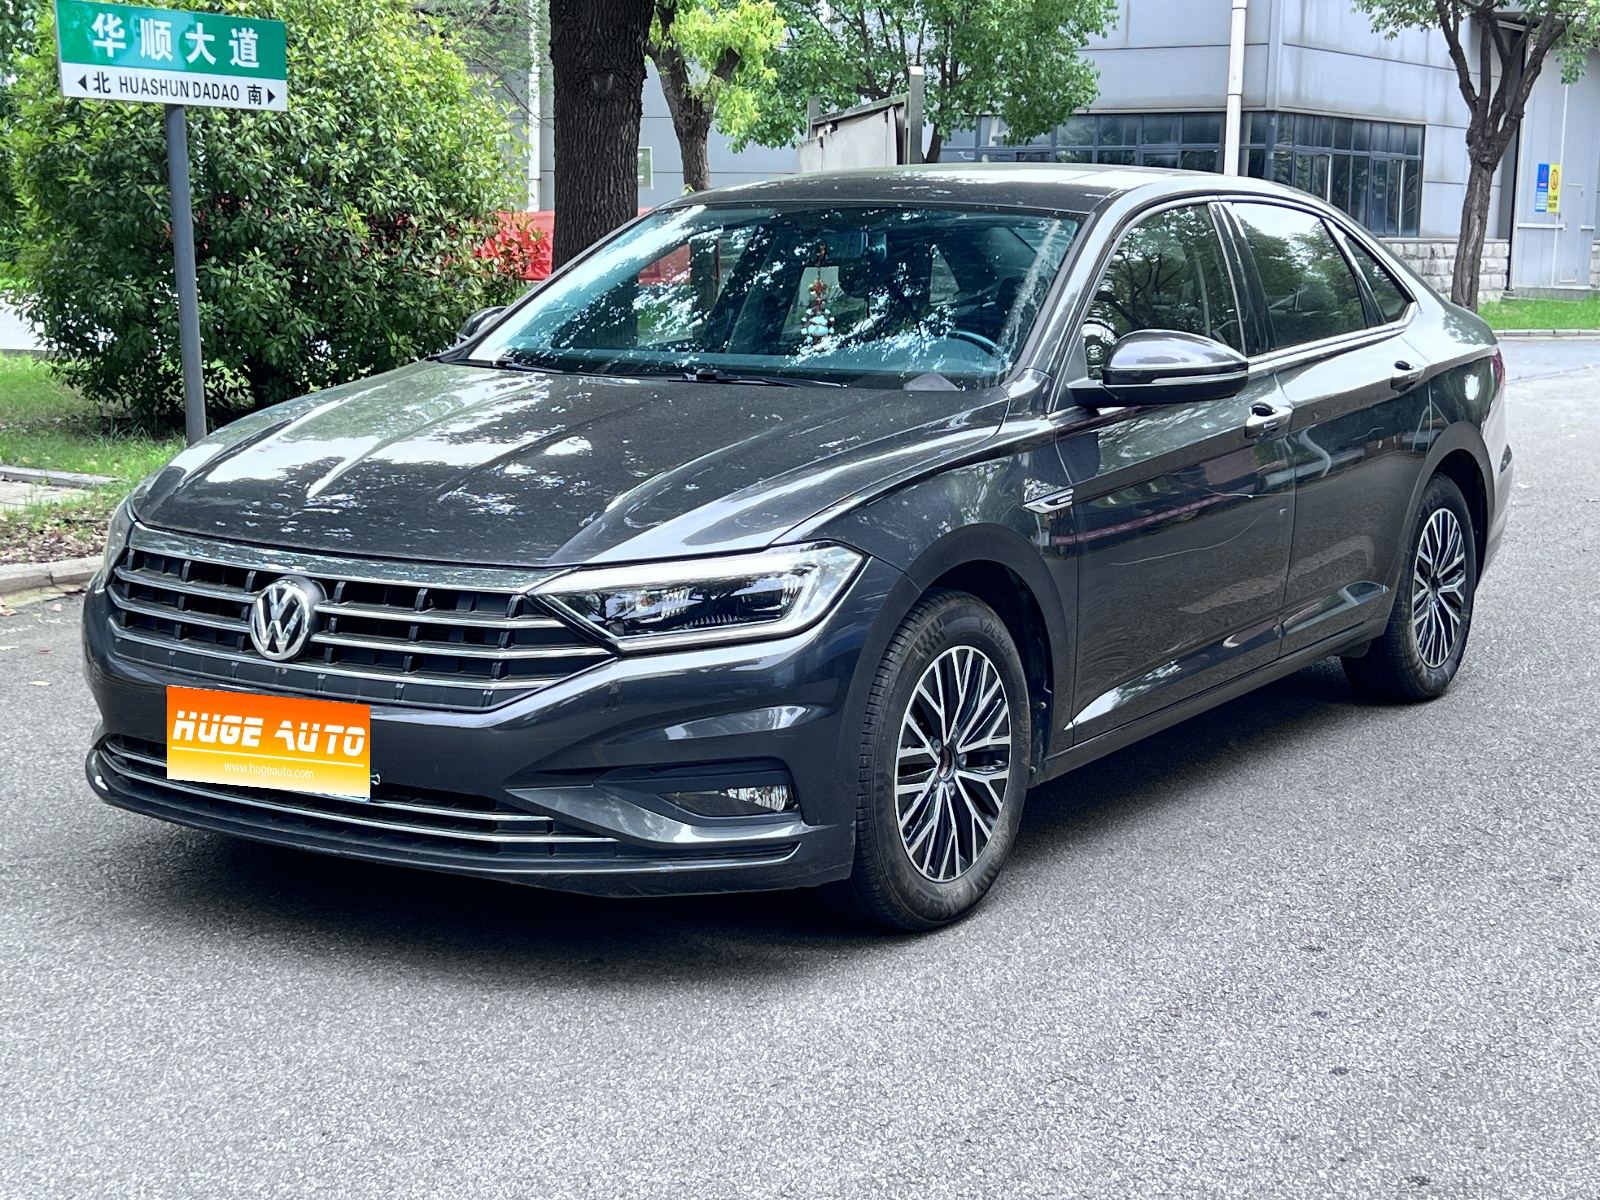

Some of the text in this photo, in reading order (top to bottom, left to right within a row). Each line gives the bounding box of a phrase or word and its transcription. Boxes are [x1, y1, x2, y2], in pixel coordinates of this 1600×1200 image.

[91, 12, 260, 68] 华顺大道
[93, 71, 111, 94] 北
[118, 75, 239, 102] HUASHUN DADAO
[246, 83, 263, 106] 南
